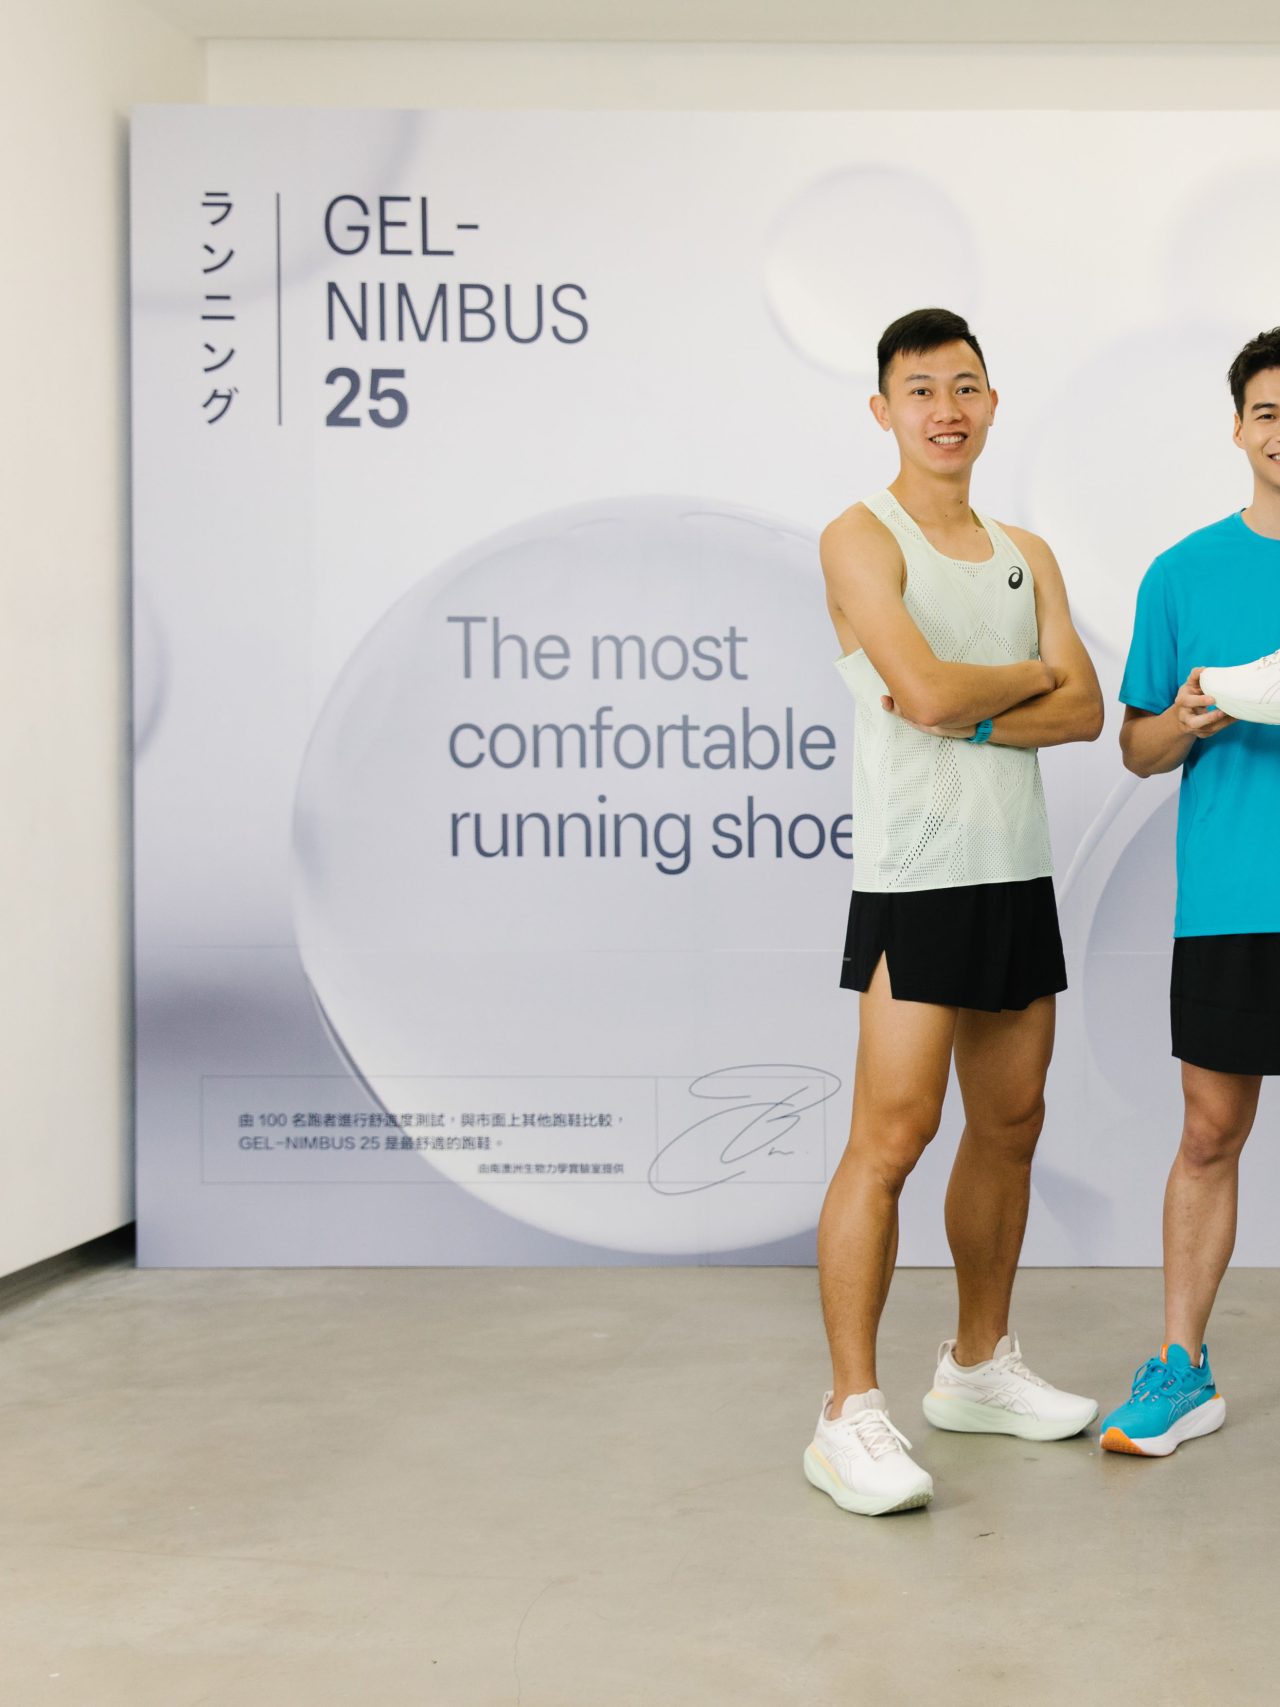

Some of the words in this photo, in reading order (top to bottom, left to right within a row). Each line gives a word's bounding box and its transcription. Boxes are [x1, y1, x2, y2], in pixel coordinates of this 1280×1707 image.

[324, 194, 480, 256] GEL-
[201, 191, 239, 425] ランニング
[327, 281, 590, 344] NIMBUS
[324, 366, 410, 429] 25
[447, 615, 572, 680] The
[591, 626, 749, 681] most
[448, 705, 837, 771] comfortable
[450, 794, 692, 876] running
[238, 1135, 356, 1150] GEL-NIMBUS
[360, 1135, 381, 1150] 25
[259, 1112, 288, 1128] 100
